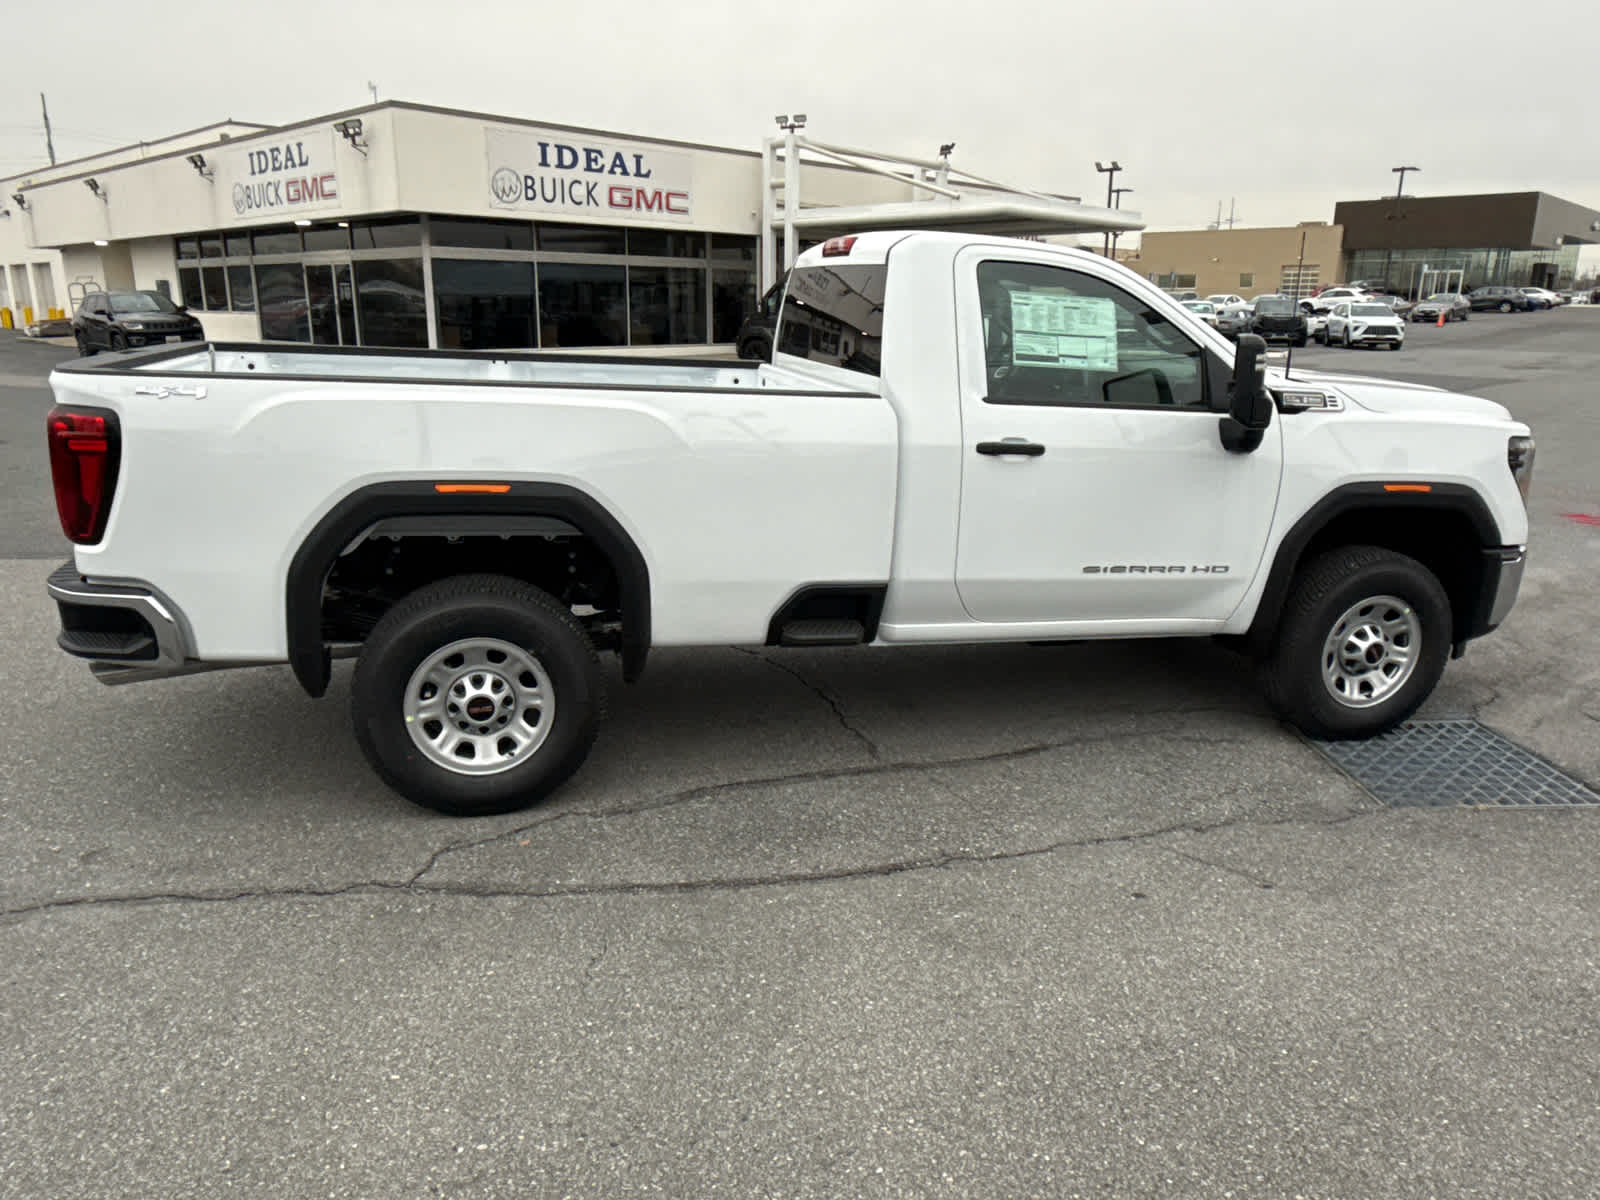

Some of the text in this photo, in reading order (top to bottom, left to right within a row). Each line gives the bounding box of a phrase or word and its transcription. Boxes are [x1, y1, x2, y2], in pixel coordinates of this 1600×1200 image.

[248, 142, 309, 176] IDEAL
[537, 142, 652, 178] IDEAL
[245, 174, 337, 209] BUICK GMC
[524, 174, 689, 215] BUICK GMC
[1082, 565, 1230, 574] SIERRA HD
